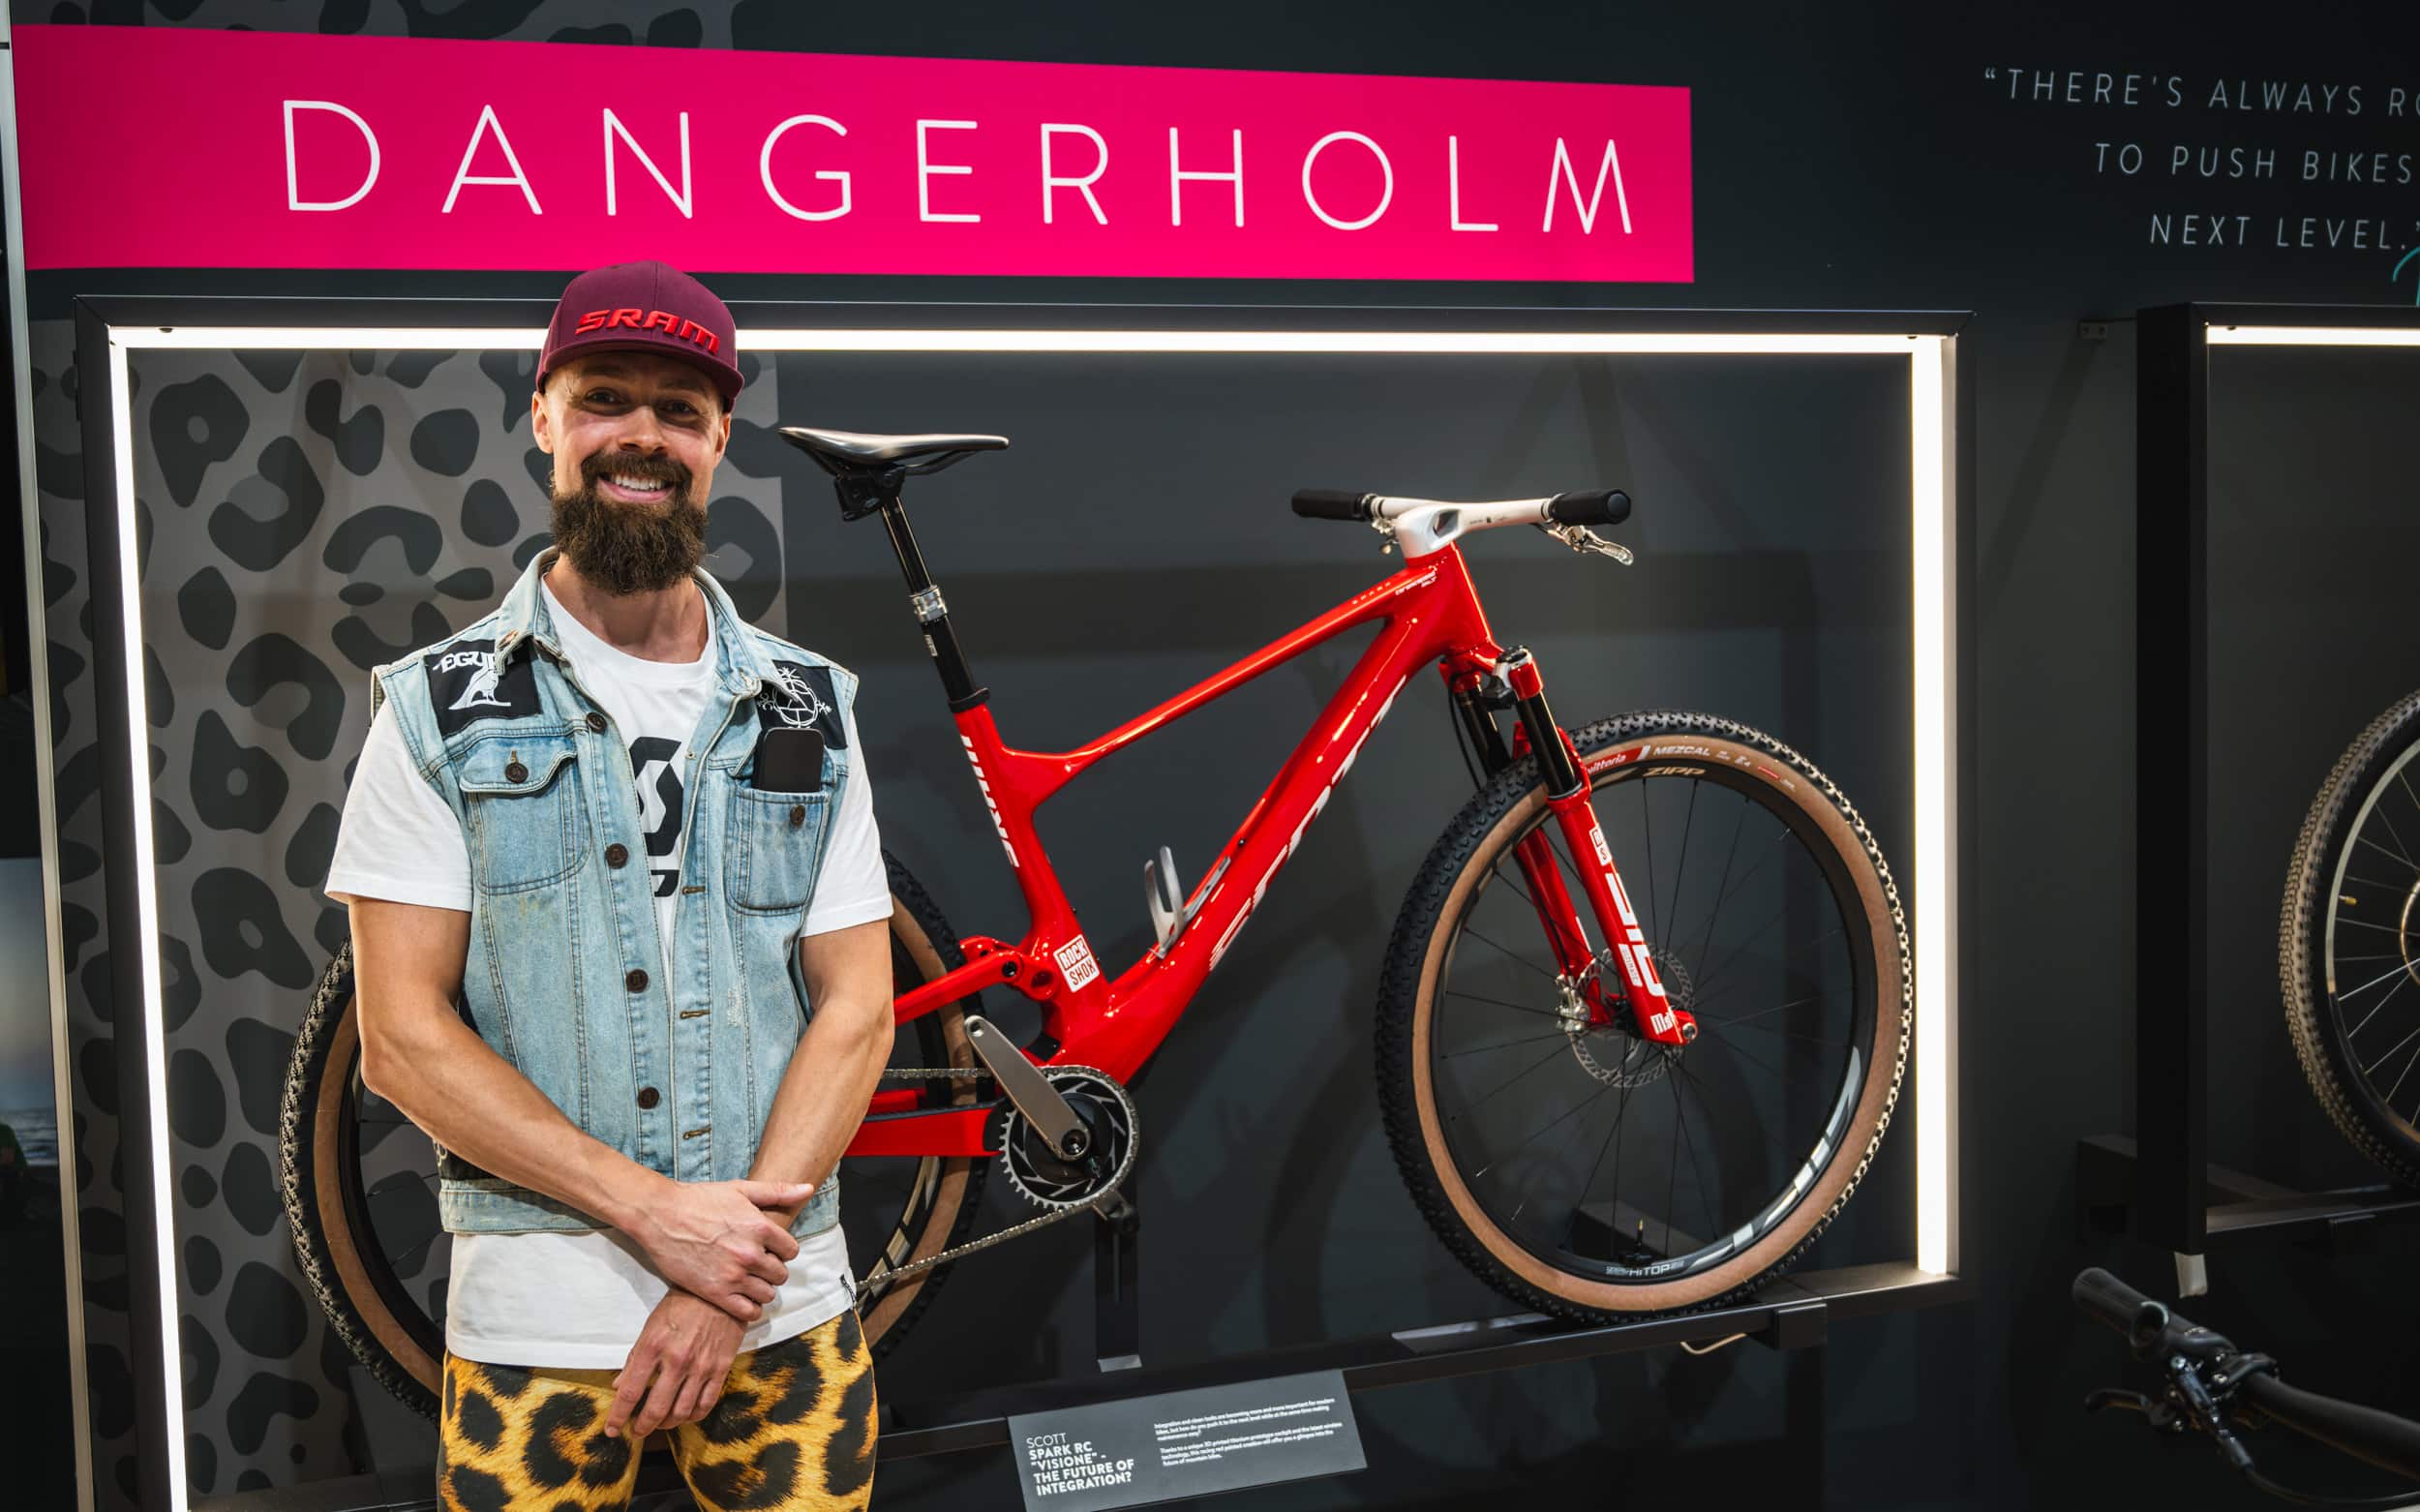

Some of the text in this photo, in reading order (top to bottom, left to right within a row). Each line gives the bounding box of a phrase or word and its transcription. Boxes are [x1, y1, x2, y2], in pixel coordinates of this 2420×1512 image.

[2208, 79, 2361, 115] ALWAYS
[284, 101, 1632, 235] DANGERHOLM
[2095, 143, 2411, 184] TO PUSH BIKES
[2150, 215, 2251, 246] NEXT
[575, 309, 720, 355] SRAM
[1652, 746, 1711, 757] MEZCAL
[1643, 767, 1706, 776] ZIPP
[1059, 939, 1088, 970] ROCK
[1069, 959, 1097, 985] SHOX
[1026, 1433, 1067, 1449] SCOTT
[1028, 1440, 1093, 1461] SPARK RC
[1033, 1458, 1135, 1485] THE FUTURE OF
[1036, 1471, 1133, 1497] INTEGRATION?
